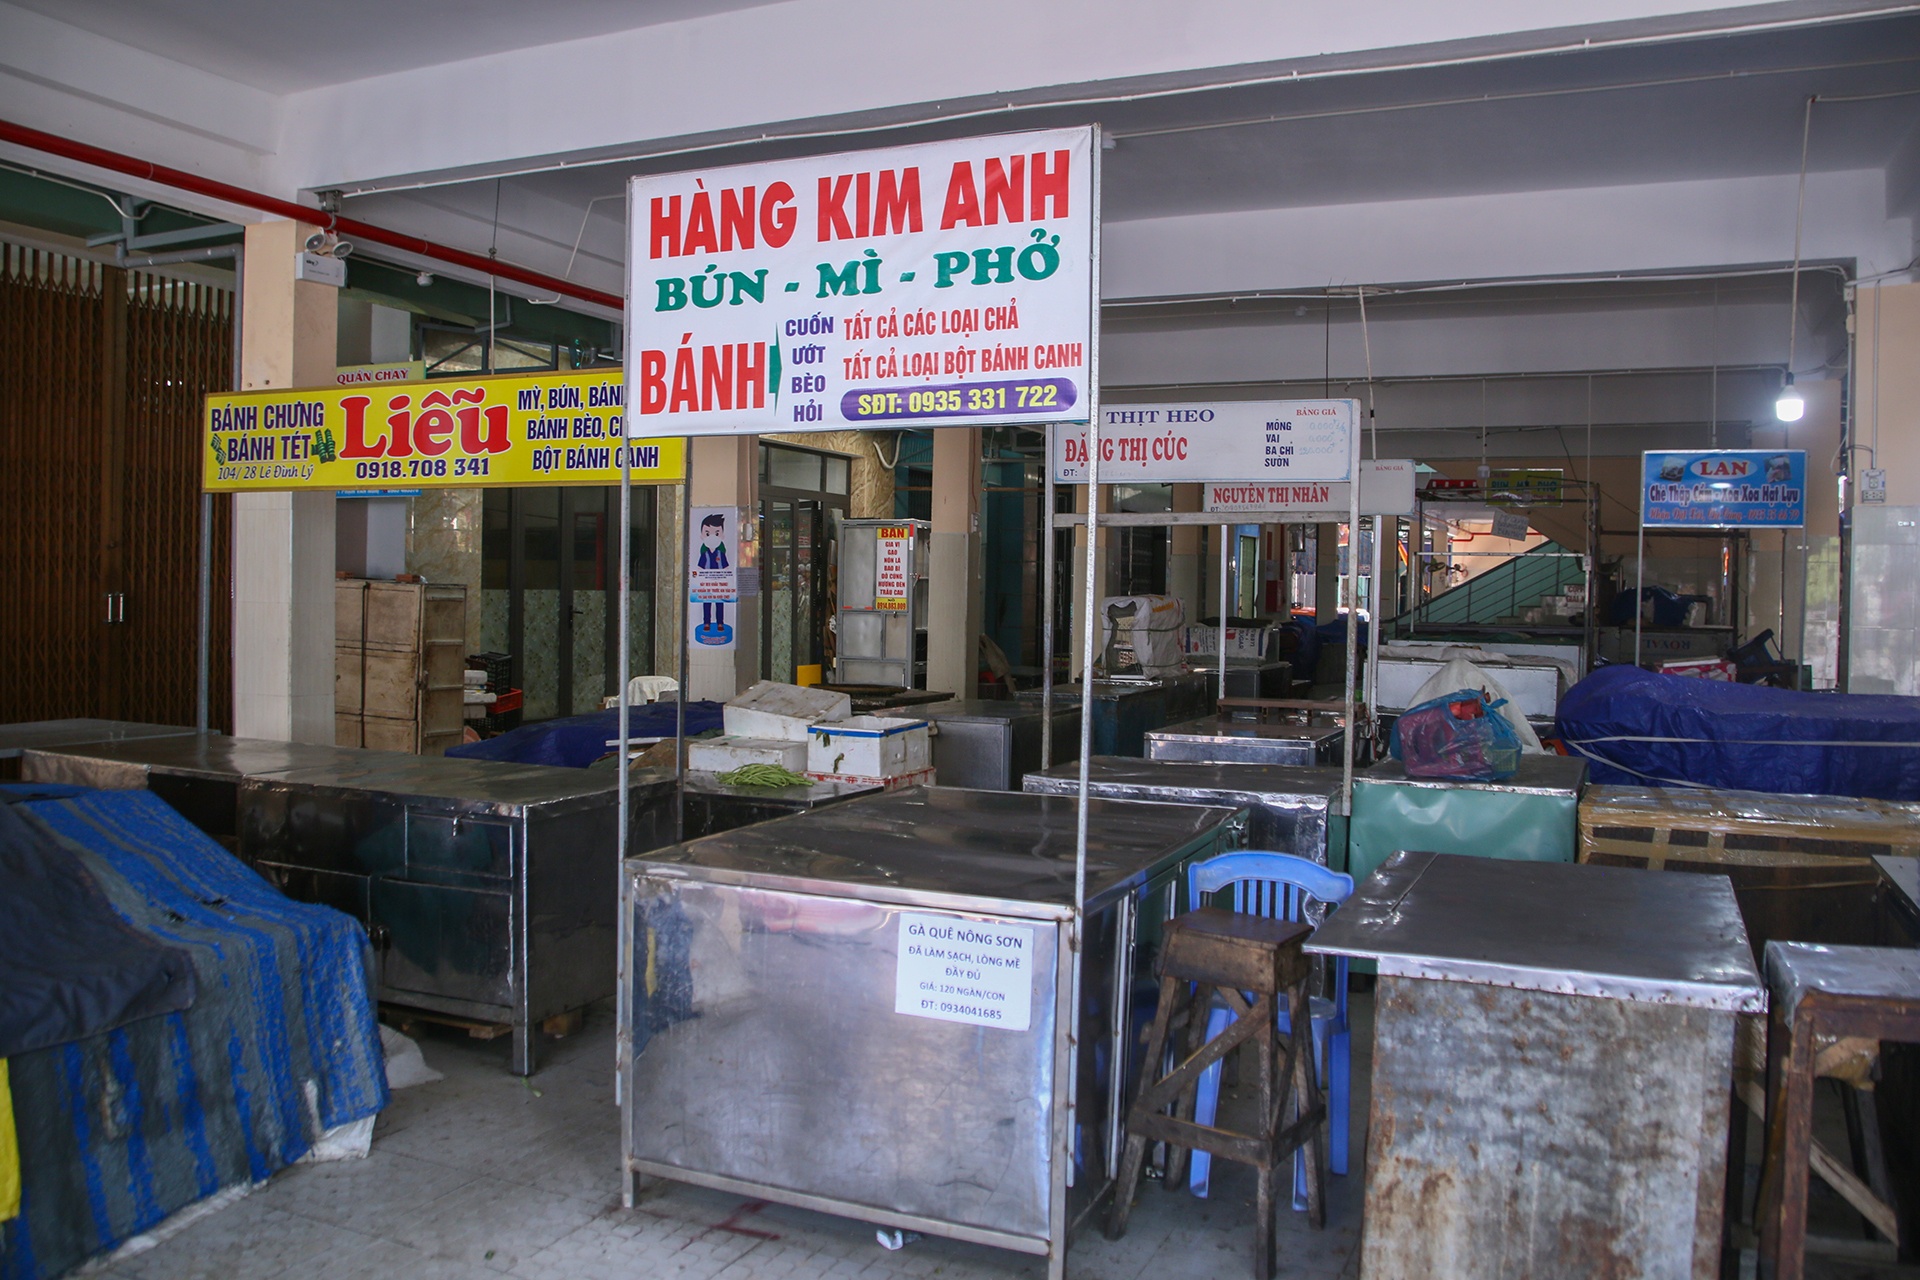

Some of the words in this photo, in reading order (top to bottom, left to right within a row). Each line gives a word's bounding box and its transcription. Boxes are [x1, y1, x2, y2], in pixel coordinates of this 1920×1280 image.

[650, 178, 797, 259] HÀNG
[817, 167, 923, 242] KIM
[940, 149, 1070, 230] ANH
[654, 264, 768, 312] BÚN
[816, 249, 883, 299] MÌ
[933, 228, 1060, 289] PHỞ
[785, 311, 834, 336] CUỐN
[844, 309, 872, 340] TẤT
[876, 307, 898, 339] CẢ
[903, 308, 936, 336] CÁC
[942, 308, 979, 338] LOẠI
[984, 298, 1019, 331] CHẢ
[792, 343, 826, 365] ƯỚT
[843, 349, 872, 380] TẤT
[876, 347, 898, 379] CẢ
[903, 352, 939, 381] LOẠI
[944, 345, 976, 379] BỘT
[981, 343, 1028, 372] BÁNH
[1034, 343, 1082, 370] CANH
[375, 369, 409, 381] CHAY
[640, 333, 766, 415] BÁNH
[791, 373, 826, 393] BÈO
[518, 385, 544, 412] MỲ,
[548, 384, 584, 410] BÚN,
[858, 393, 902, 415] SĐT:
[909, 389, 961, 413] 0935
[968, 387, 1005, 410] 331
[1015, 385, 1057, 407] 722
[211, 404, 257, 432] BÁNH
[264, 401, 324, 429] CHƯNG
[794, 399, 822, 422] HỎI
[1106, 410, 1160, 426] THỊT
[1166, 409, 1215, 423] HEO
[1296, 407, 1320, 416] BẢNG
[1321, 407, 1337, 415] GIÁ
[527, 415, 568, 440] BÁNH
[573, 413, 606, 440] BÈO,
[228, 433, 275, 462] BÁNH
[1118, 437, 1148, 467] THỊ
[1152, 430, 1188, 461] CÚC
[1266, 434, 1280, 443] VAI
[533, 445, 562, 474] BỘT
[566, 444, 610, 469] BÁNH
[1265, 446, 1277, 455] BA
[259, 465, 271, 479] Lê
[274, 464, 298, 478] Đình
[301, 464, 314, 480] Lý
[356, 459, 447, 479] 0918.708
[454, 457, 489, 476] 341
[1700, 461, 1748, 476] LAN
[1268, 487, 1289, 507] THỊ
[1742, 485, 1759, 501] Xoa
[1762, 485, 1779, 506] Hạt
[909, 923, 925, 936] GÀ
[929, 927, 953, 940] QUÊ
[957, 929, 992, 945] NÔNG
[996, 935, 1023, 949] SƠN
[908, 944, 922, 955] ĐÃ
[924, 948, 945, 959] LÀM
[947, 951, 974, 964] SẠCH,
[976, 953, 1002, 967] LÒNG
[1005, 956, 1021, 969] MỀ
[945, 965, 964, 978] ĐẦY
[967, 968, 981, 981] ĐỦ
[919, 981, 937, 992] GIÁ:
[940, 984, 954, 994] 120
[957, 986, 1005, 1001] NGÀN/CON
[921, 1000, 937, 1011] ĐT:
[940, 1003, 1002, 1020] 0934041685
